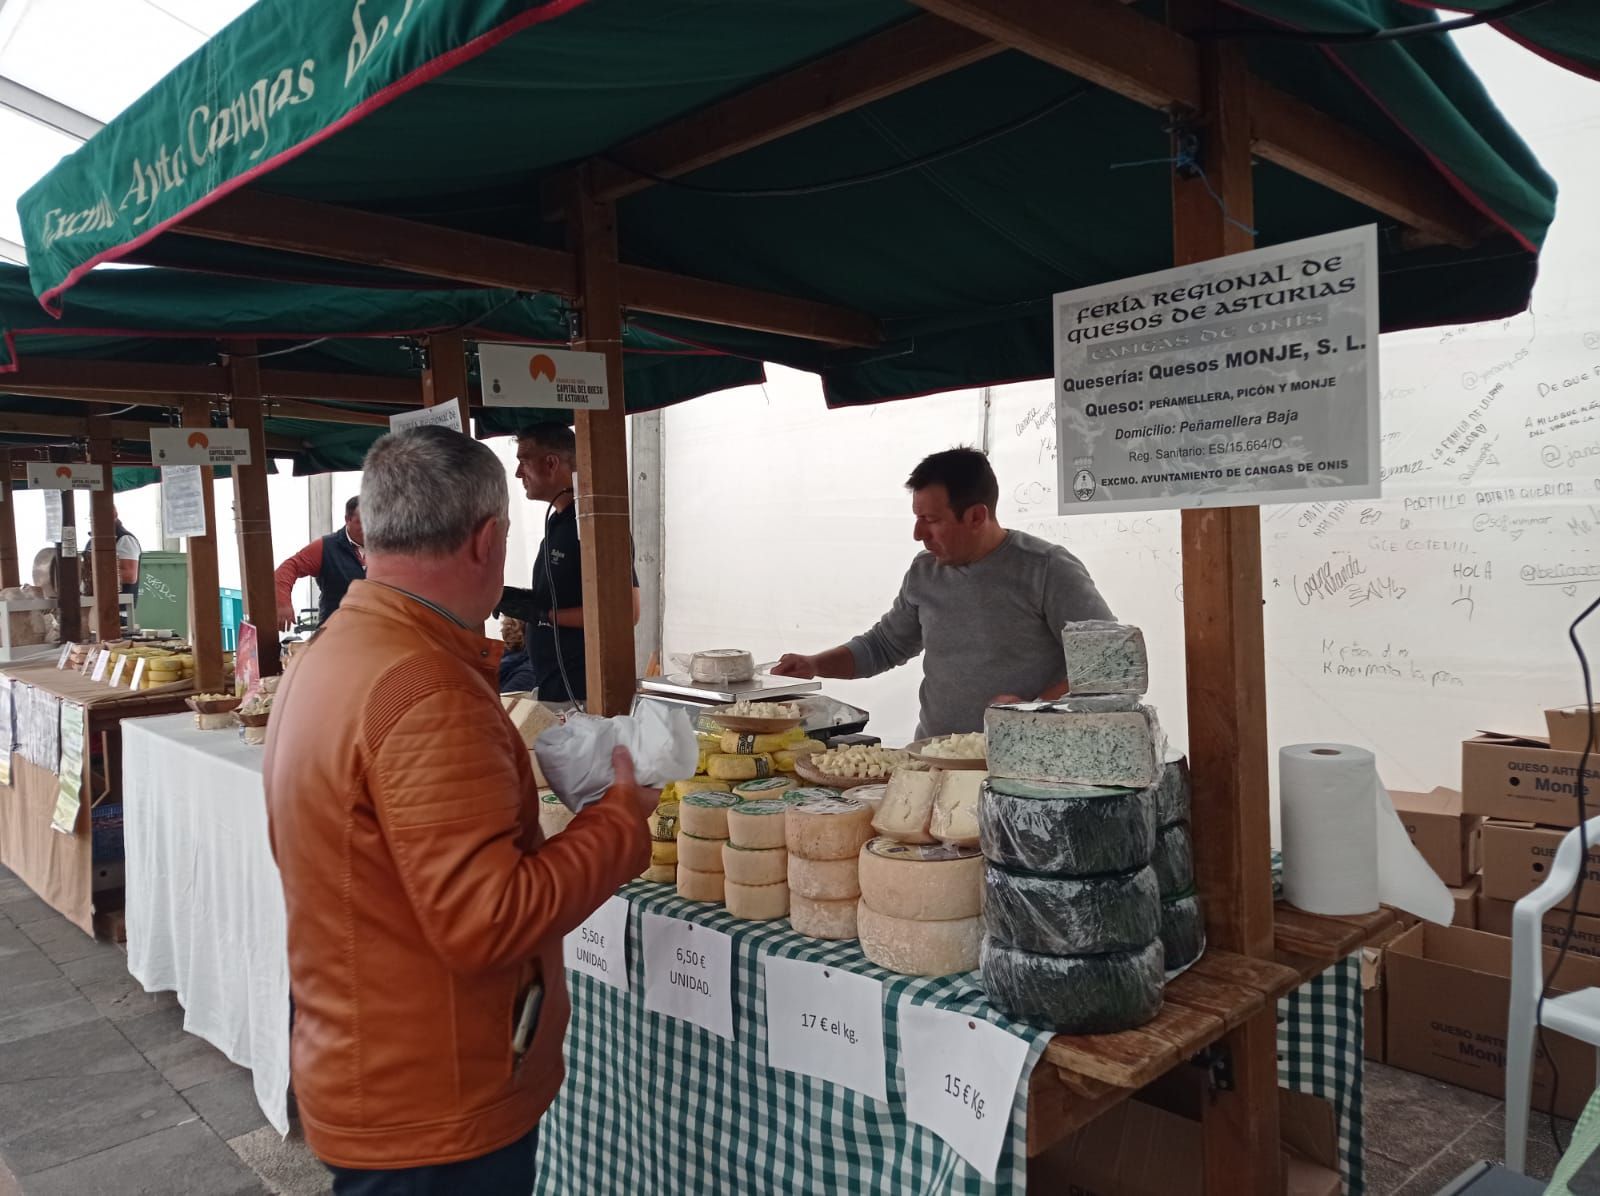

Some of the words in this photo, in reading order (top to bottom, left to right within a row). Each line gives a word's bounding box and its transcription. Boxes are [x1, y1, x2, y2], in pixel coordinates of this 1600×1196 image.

[188, 58, 315, 166] Cangas
[1152, 264, 1292, 307] REGIONAL
[1302, 256, 1342, 277] DE
[1067, 313, 1163, 344] QUESOS
[1172, 305, 1207, 324] DE
[1214, 277, 1356, 316] ASTURIAS
[1063, 368, 1143, 392] Quesería:
[1150, 358, 1219, 381] Quesos
[1226, 342, 1309, 369] MONJE,
[1317, 338, 1337, 355] S.
[1346, 334, 1366, 351] L.
[1085, 400, 1144, 418] Queso:
[1150, 390, 1234, 410] PEÑAMELLERA,
[1237, 383, 1275, 399] PICÓN
[1278, 382, 1288, 393] Y
[1291, 376, 1337, 392] MONJE
[1115, 424, 1176, 440] Domicilio:
[1180, 412, 1262, 433] Peñamellera
[1266, 409, 1299, 426] Baja
[1129, 451, 1151, 463] Reg.
[1155, 445, 1206, 460] Sanitario:
[1101, 476, 1139, 487] EXCMO.
[1141, 469, 1223, 484] AYUNTAMIENTO
[1226, 468, 1242, 478] DE
[1245, 463, 1294, 476] CANGAS
[1298, 462, 1314, 472] DE
[1317, 458, 1349, 471] ONIS
[1452, 561, 1493, 580] HOLA
[1508, 761, 1549, 774] QUESO
[581, 927, 599, 946] 5,50
[600, 935, 606, 949] €
[576, 947, 609, 973] UNIDAD.
[676, 947, 699, 966] 6,50
[700, 955, 706, 969] €
[670, 970, 712, 998] UNIDAD.
[801, 1013, 817, 1028] 17
[820, 1017, 829, 1031] €
[831, 1021, 840, 1036] el
[843, 1023, 858, 1045] kg.
[944, 1074, 961, 1098] 15
